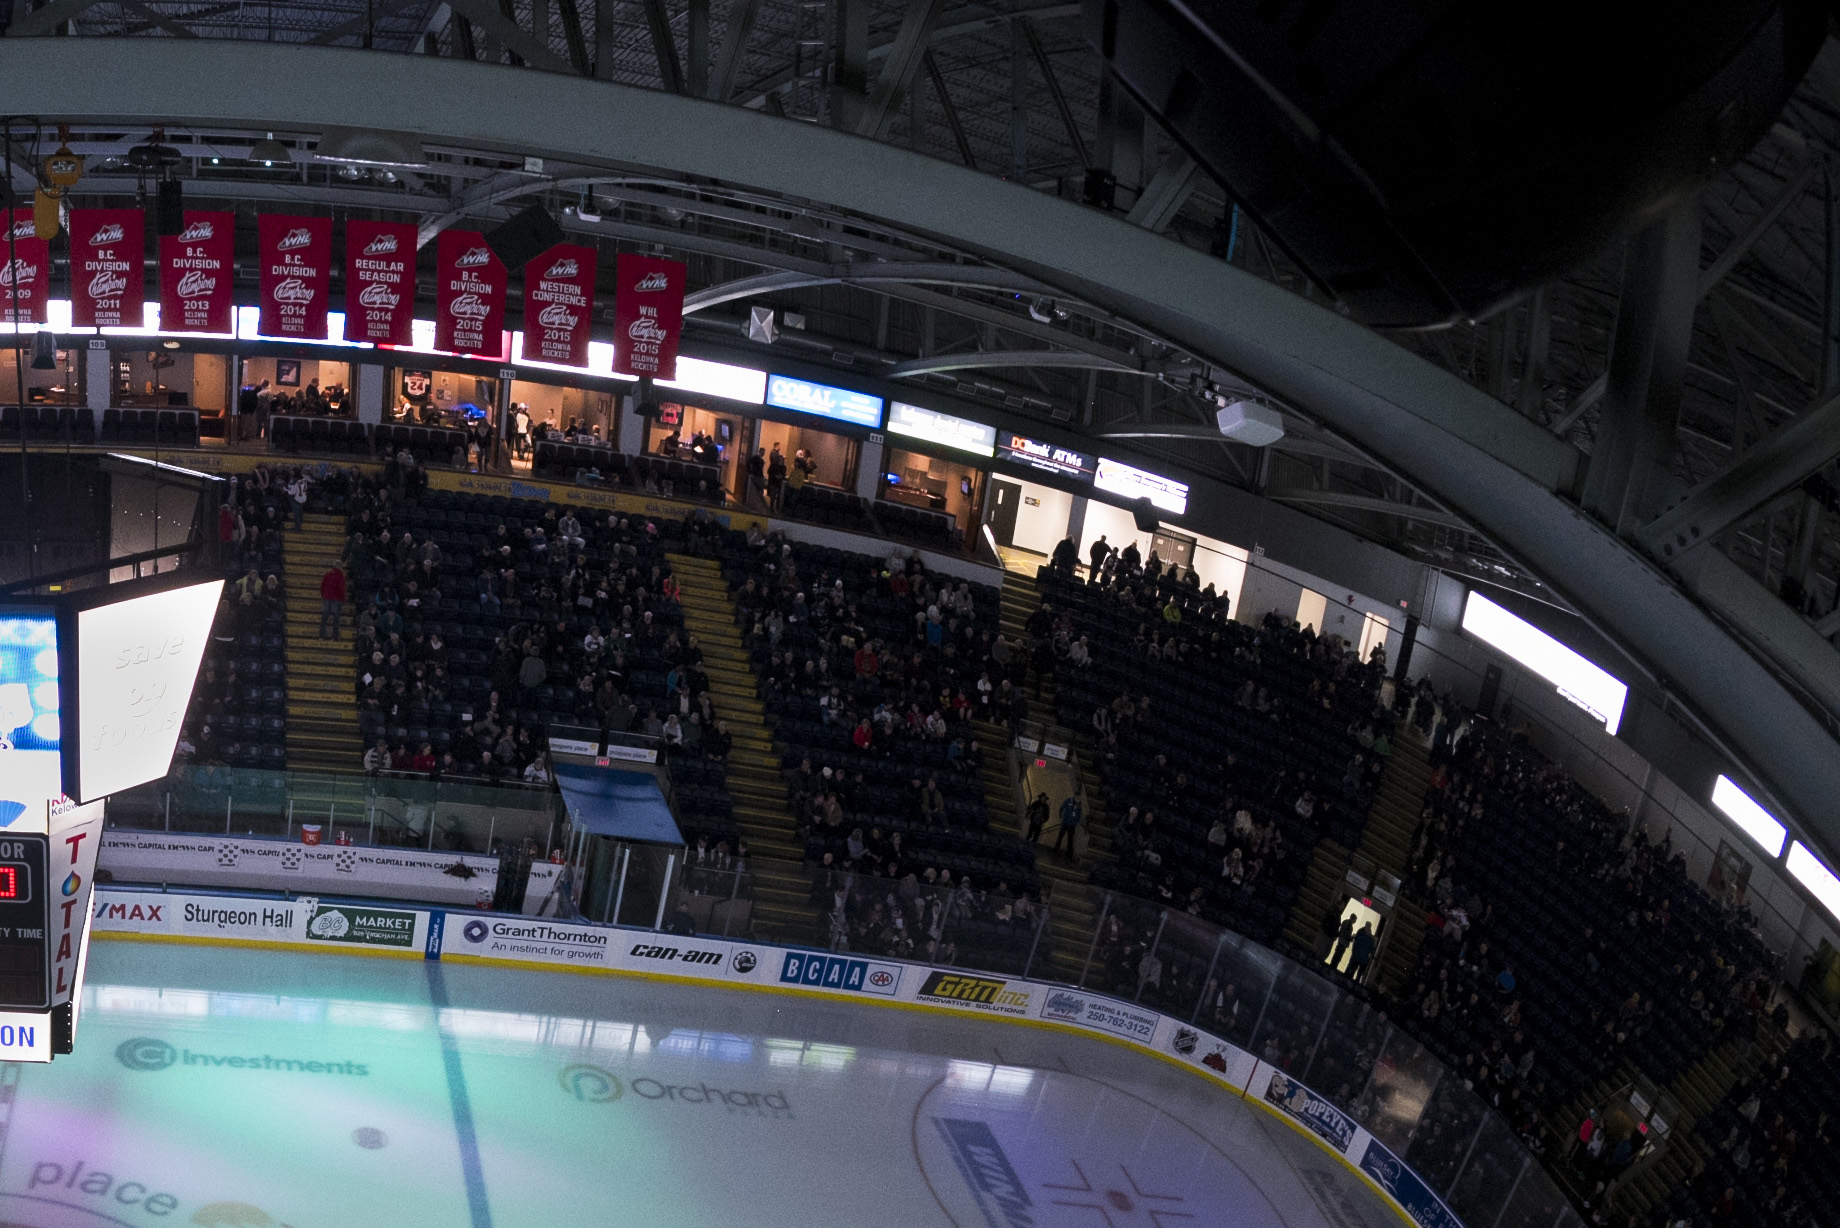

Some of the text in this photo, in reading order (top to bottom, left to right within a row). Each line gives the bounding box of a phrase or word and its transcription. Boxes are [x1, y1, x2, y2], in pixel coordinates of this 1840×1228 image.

[98, 250, 116, 259] B.C.
[186, 247, 206, 257] B.C.
[173, 258, 220, 269] DIVISION
[285, 254, 304, 264] B.C.
[355, 259, 404, 272] REGULAR
[85, 261, 130, 271] DIVISION
[272, 265, 316, 277] DIVISION
[359, 271, 401, 283] SEASON
[461, 271, 481, 282] B.C.
[88, 271, 127, 298] Champions
[177, 271, 216, 298] Champions
[274, 278, 315, 304] Champions
[450, 280, 492, 294] DIVISION
[539, 280, 581, 295] WESTERN
[359, 283, 400, 309] Champions
[532, 290, 587, 306] CONFERENCE
[96, 299, 120, 308] 2011
[183, 300, 209, 310] 2013
[280, 305, 306, 315] 2014
[450, 293, 491, 320] Champions
[366, 310, 392, 321] 2014
[538, 304, 578, 330] Champions
[639, 305, 658, 317] WHL
[456, 320, 483, 331] 2015
[629, 318, 666, 344] Champions
[454, 331, 483, 341] KELOWNA
[544, 330, 571, 342] 2015
[90, 340, 105, 349] 109
[455, 338, 483, 348] ROCKETS
[541, 341, 571, 351] KELOWNA
[633, 343, 659, 354] 2015
[542, 349, 570, 359] ROCKETS
[630, 354, 659, 365] KELOWNA
[500, 370, 515, 379] 110
[410, 382, 424, 392] 24
[771, 377, 836, 408] CORAL
[1053, 450, 1083, 468] ATMs
[137, 842, 167, 851] CAPITAL
[375, 858, 404, 867] CAPITAL
[184, 902, 293, 929] Sturgeon Hall
[355, 915, 412, 930] MARKET
[15, 928, 43, 940] TIME
[492, 922, 608, 945] GrantThornton
[491, 942, 604, 961] An instinct for growth
[629, 943, 724, 966] can-am
[786, 956, 861, 987] BCAA
[932, 975, 1004, 1004] GRM
[916, 995, 1026, 1015] INNOVATIVE SOLUTIONS
[1088, 1002, 1117, 1015] HEATING
[1121, 1010, 1155, 1027] PLUMBING
[1086, 1010, 1151, 1036] 250-762-3122
[182, 1049, 370, 1077] Investments
[631, 1077, 790, 1112] Orchard
[1301, 1099, 1353, 1146] POPEYE'S
[28, 1157, 180, 1219] place
[1431, 1200, 1442, 1213] IN
[1423, 1207, 1436, 1222] OF
